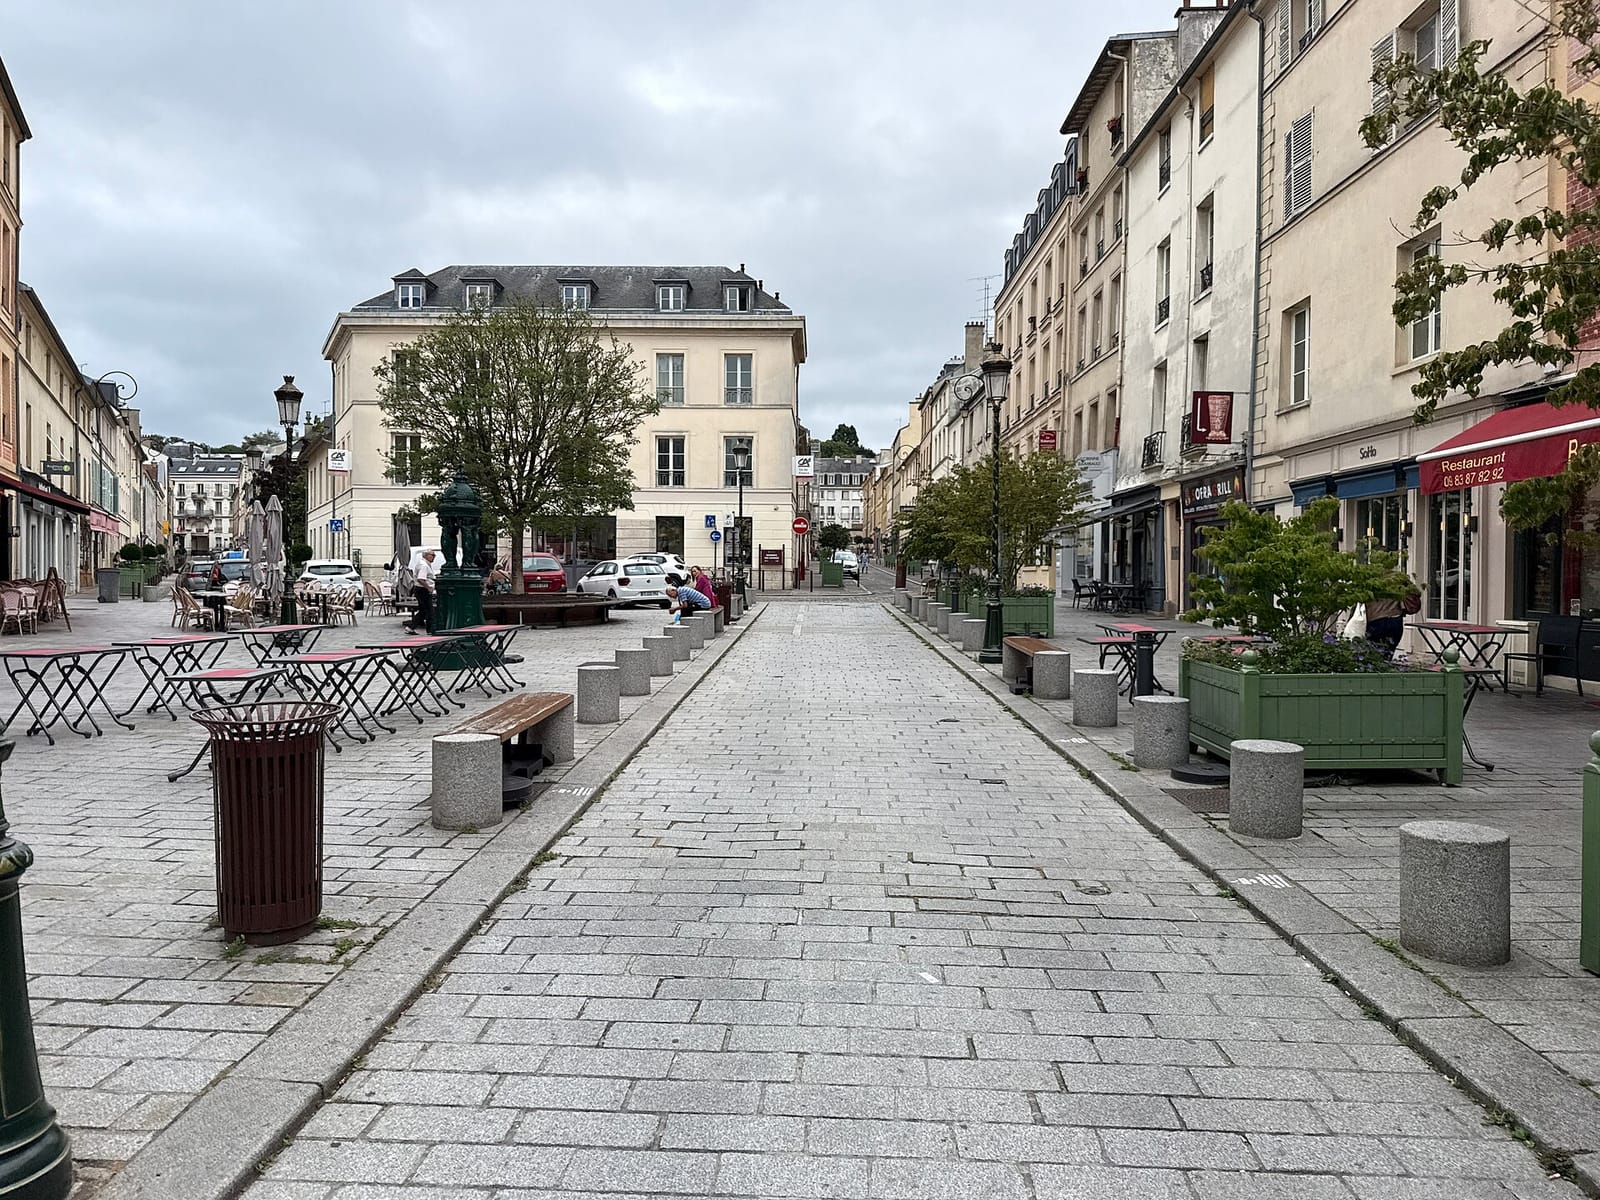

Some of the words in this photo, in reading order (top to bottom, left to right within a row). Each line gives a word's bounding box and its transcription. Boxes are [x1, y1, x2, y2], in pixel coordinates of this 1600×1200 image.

[1359, 445, 1377, 460] SoHo
[1441, 451, 1506, 472] Restaurant
[1443, 475, 1453, 487] 09
[1454, 474, 1464, 486] 83
[1465, 472, 1476, 485] 87
[1477, 470, 1490, 482] 82
[1491, 467, 1504, 480] 92
